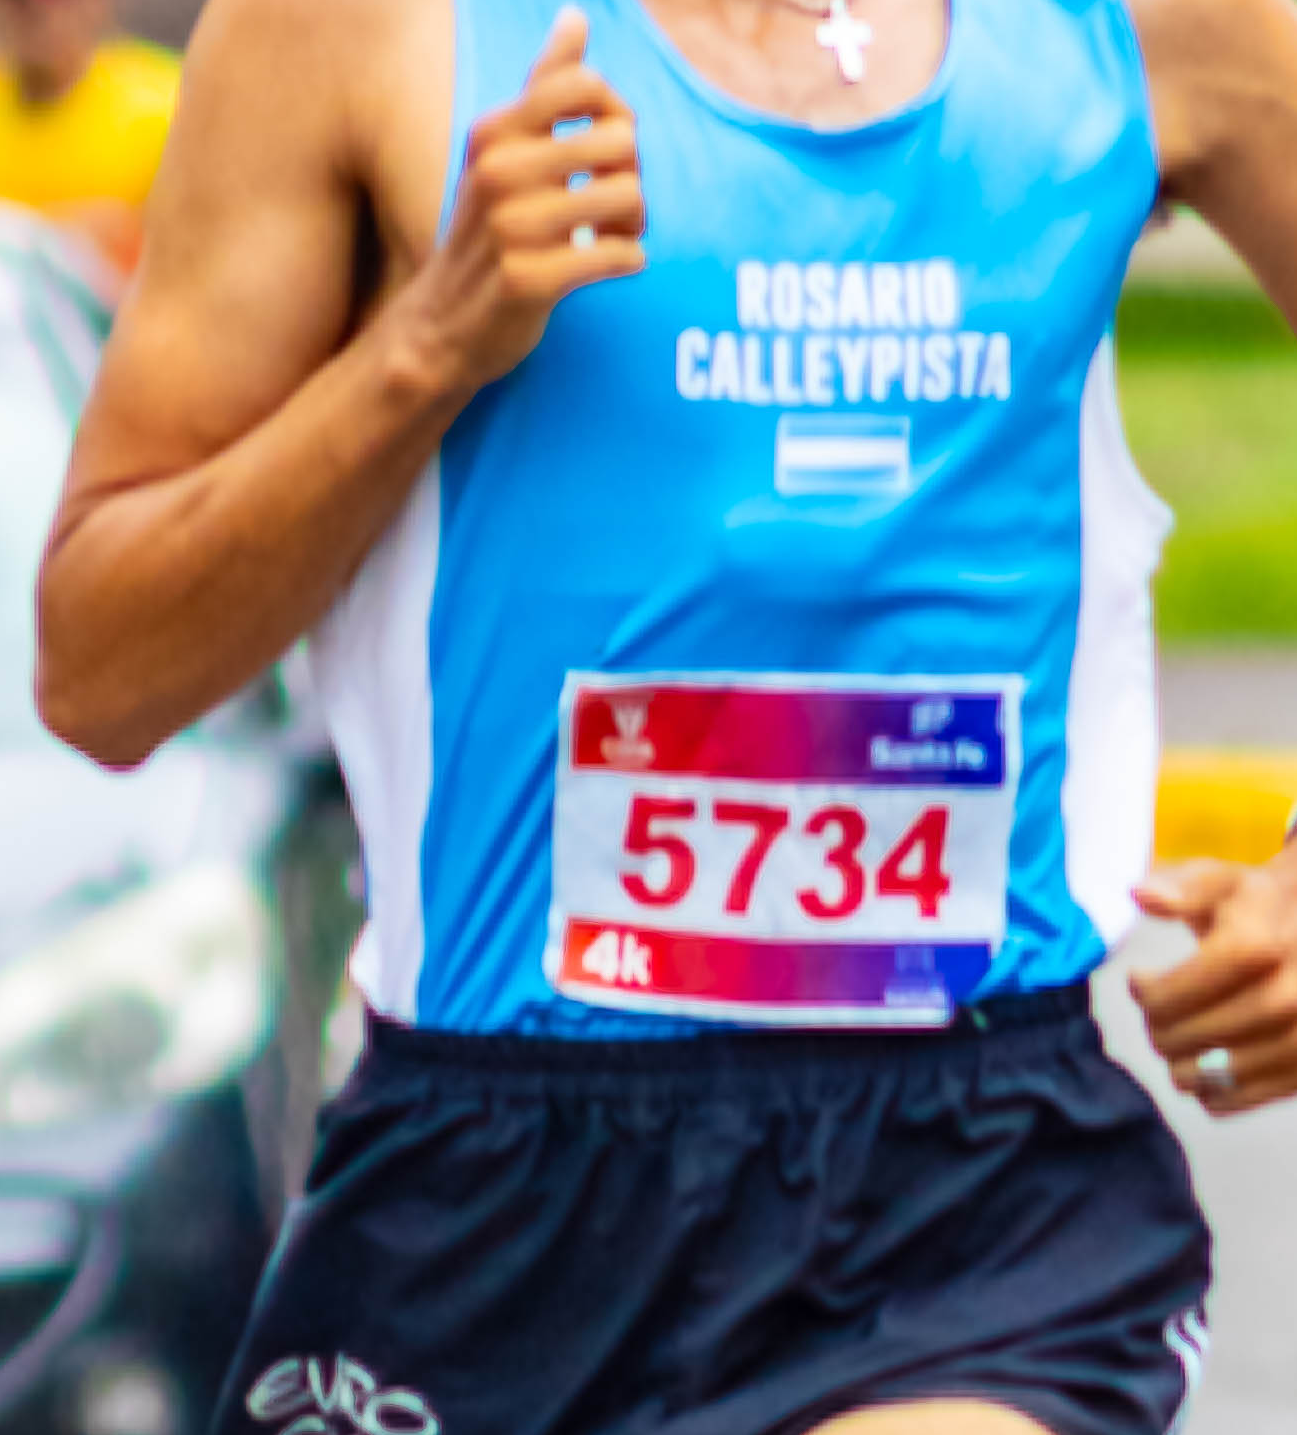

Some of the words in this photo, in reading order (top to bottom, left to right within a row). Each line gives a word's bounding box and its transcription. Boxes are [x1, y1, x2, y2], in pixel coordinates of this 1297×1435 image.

[736, 259, 960, 331] ROSARIO
[675, 326, 1012, 406] CALLEYPISTA
[619, 791, 952, 920] 5734
[581, 930, 654, 986] 4k
